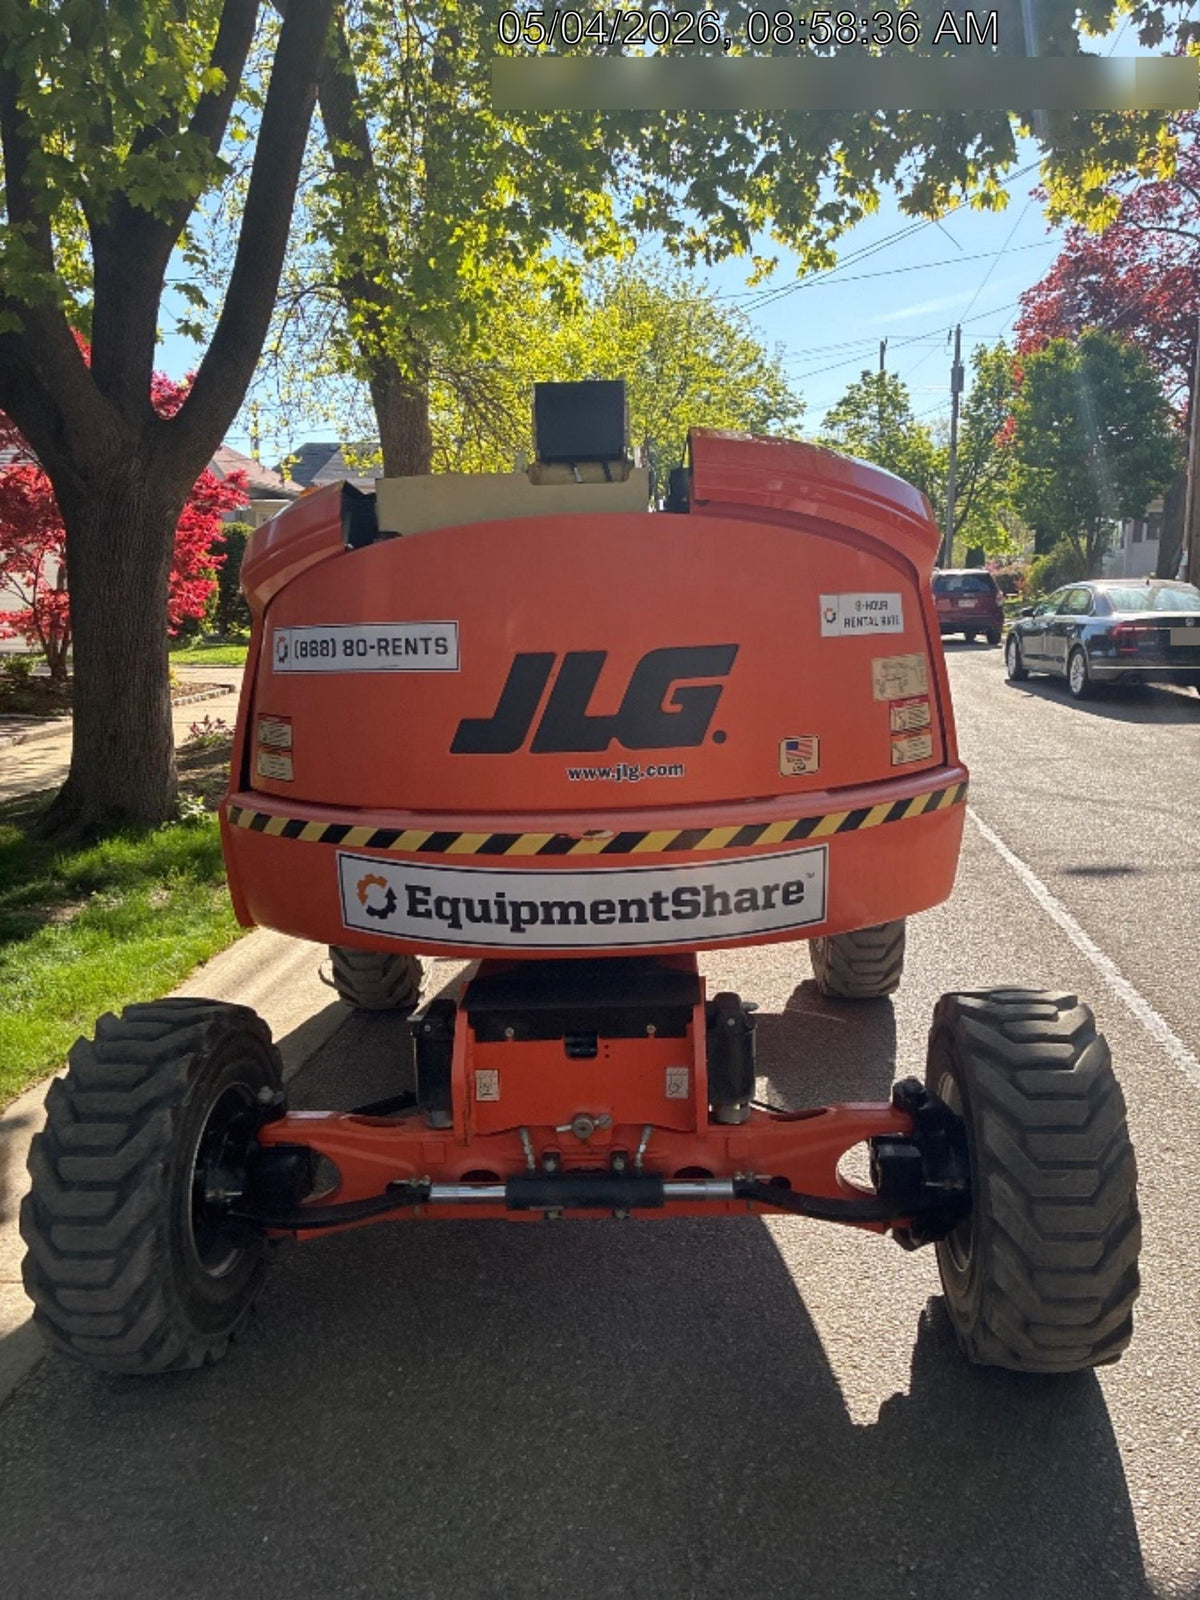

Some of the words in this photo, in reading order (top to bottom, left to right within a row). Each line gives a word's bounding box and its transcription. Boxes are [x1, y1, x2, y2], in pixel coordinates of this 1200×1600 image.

[844, 616, 879, 629] RENTAL
[294, 638, 337, 659] (888)
[342, 637, 449, 657] 80-RENTS
[567, 763, 684, 781] www.jlg.com
[405, 877, 805, 933] EquipmentShare
